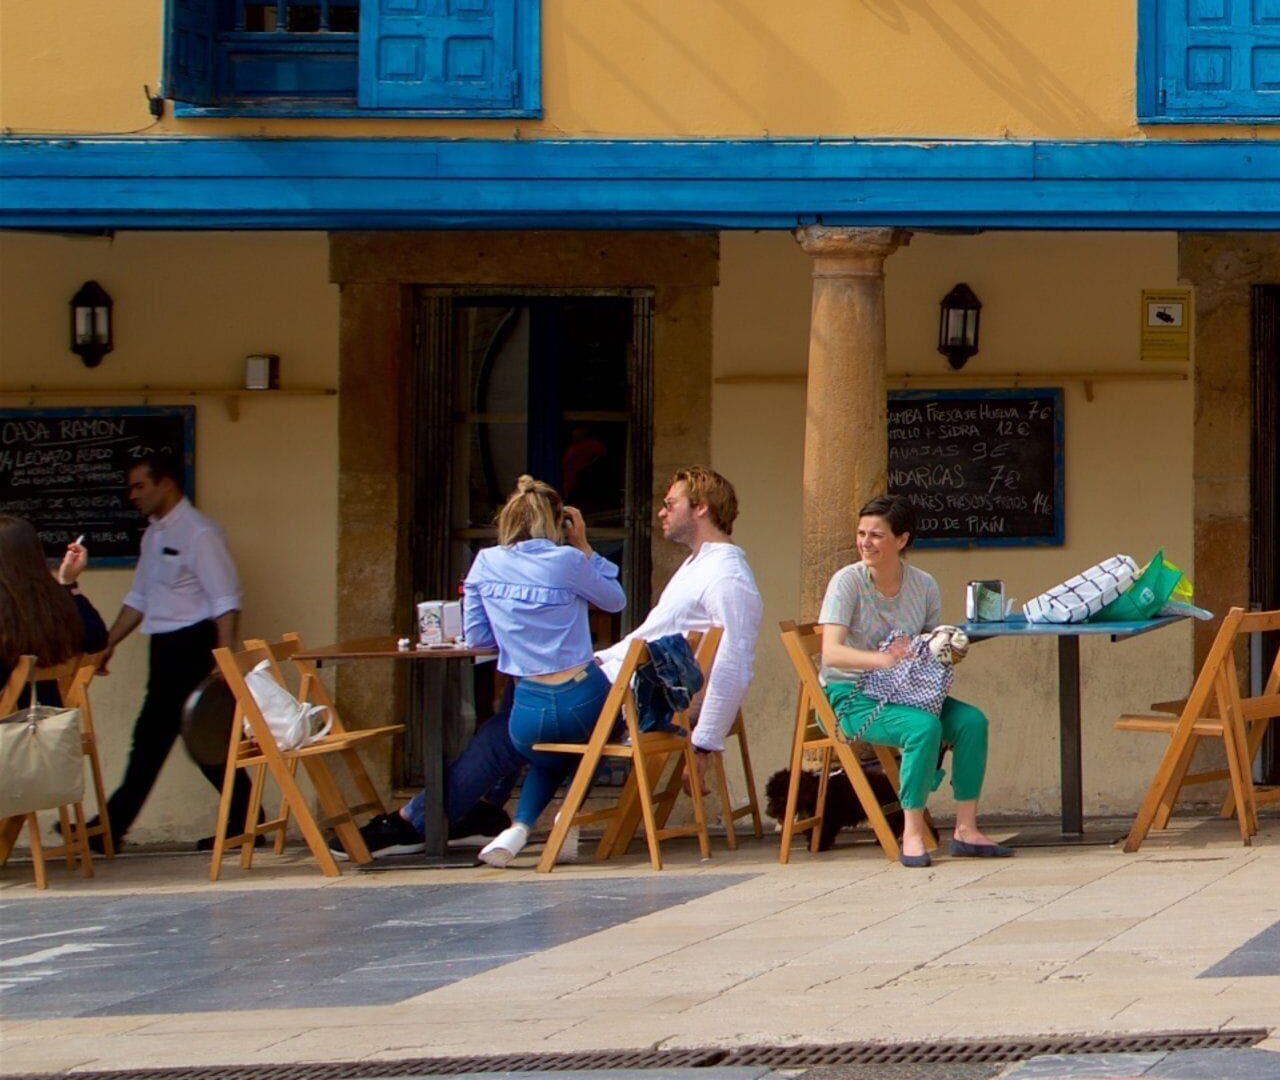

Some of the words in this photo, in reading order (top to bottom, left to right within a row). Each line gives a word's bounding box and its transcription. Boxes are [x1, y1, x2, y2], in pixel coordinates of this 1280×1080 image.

[888, 407, 924, 425] AMBA
[2, 420, 51, 445] CASA
[890, 444, 960, 460] AVAJAS
[941, 517, 961, 531] DE
